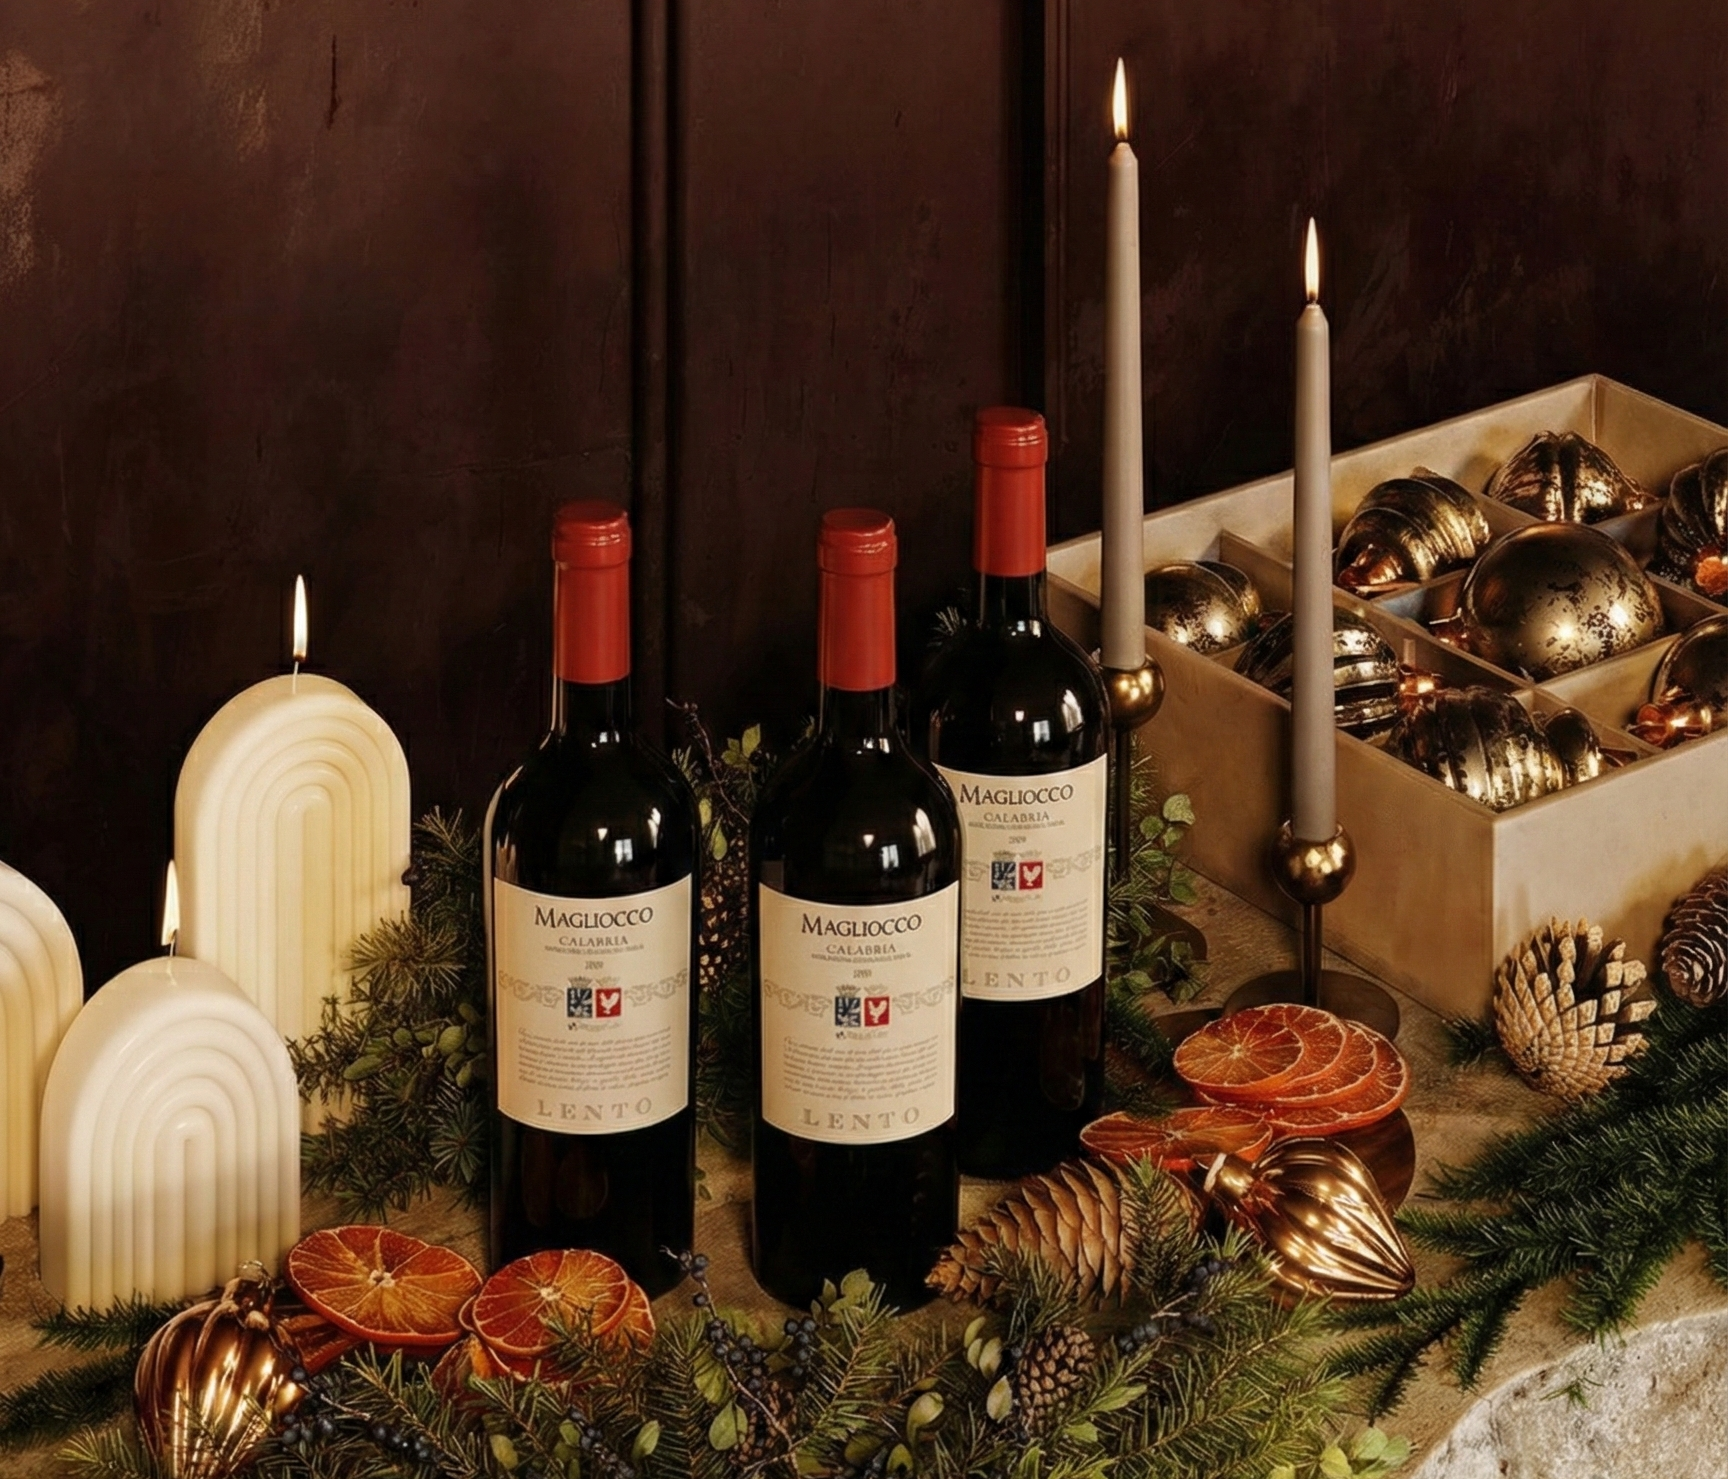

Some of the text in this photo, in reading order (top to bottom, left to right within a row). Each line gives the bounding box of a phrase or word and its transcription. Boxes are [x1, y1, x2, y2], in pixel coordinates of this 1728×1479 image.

[960, 784, 1074, 806] MAGLIOCCO
[983, 811, 1050, 824] CALABRIA
[535, 905, 654, 929] MAGLIOCCO
[801, 913, 922, 937] MAGLIOCCO
[558, 935, 628, 948] CALABRIA
[826, 943, 897, 956] CALABRIA
[963, 966, 1071, 988] LENTO
[537, 1097, 652, 1121] LENTO
[802, 1106, 920, 1131] LENTO
